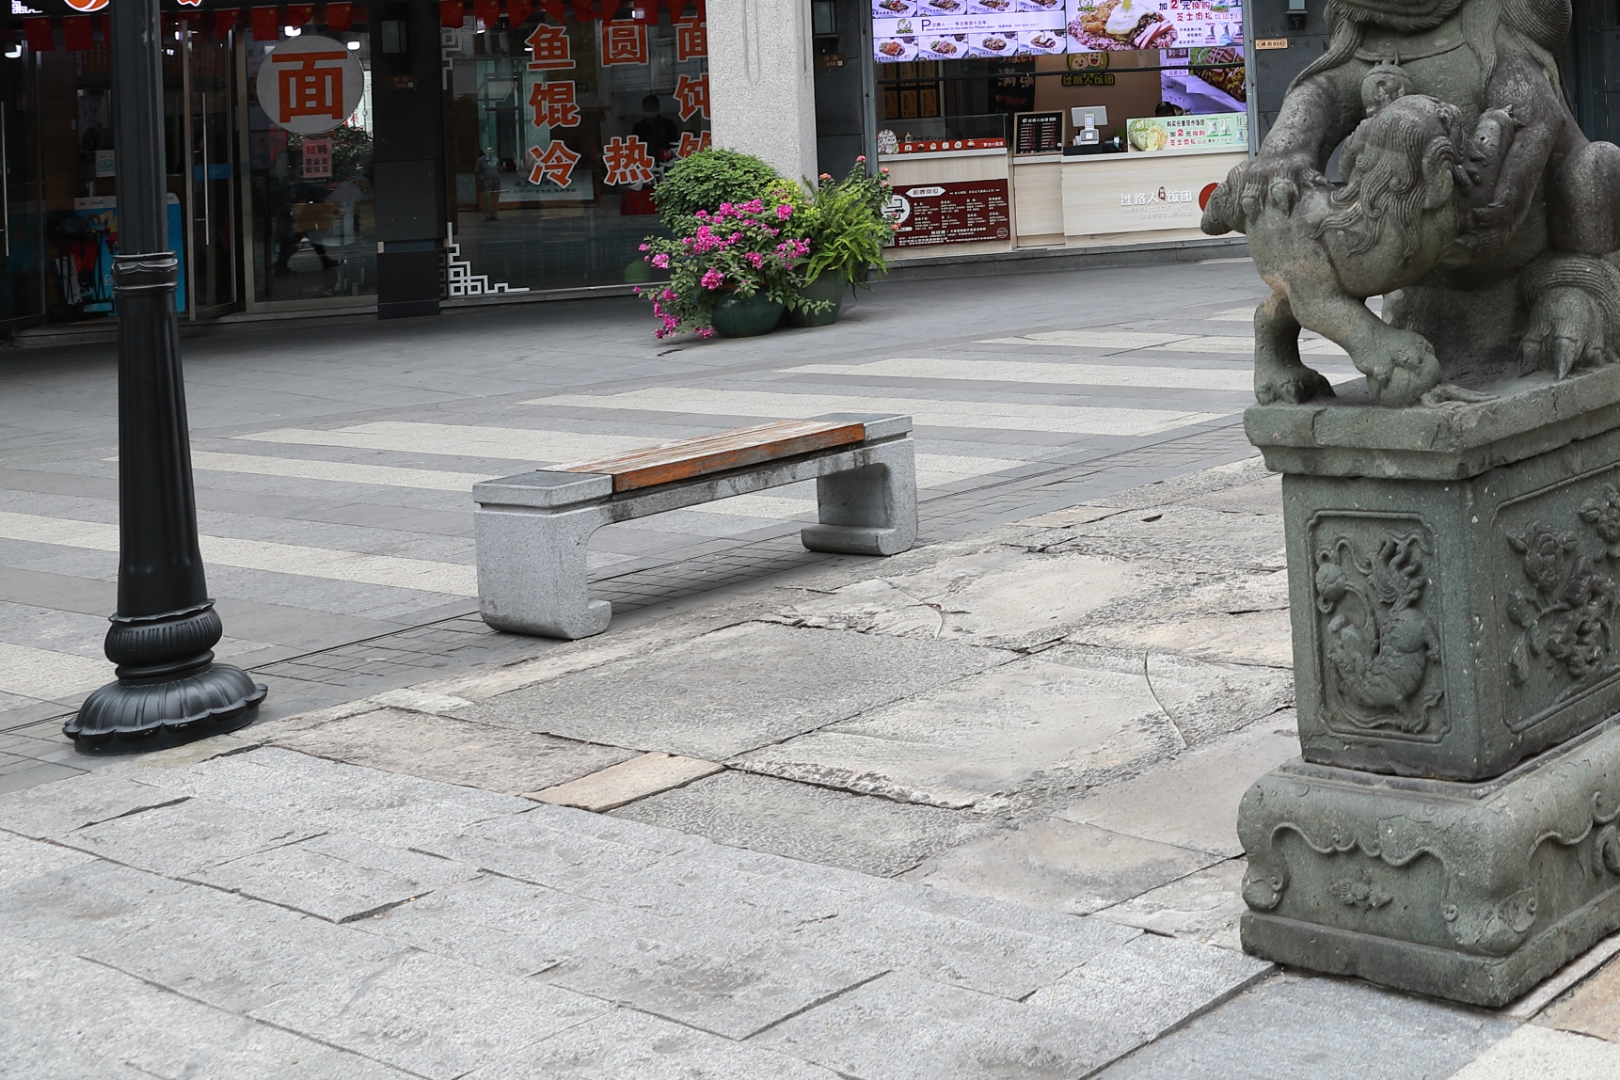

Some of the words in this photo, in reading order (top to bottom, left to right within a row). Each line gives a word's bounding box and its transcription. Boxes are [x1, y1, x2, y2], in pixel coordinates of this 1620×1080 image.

[1062, 75, 1114, 85] 过路人饭团
[271, 50, 348, 123] 面
[306, 145, 327, 155] 招聘
